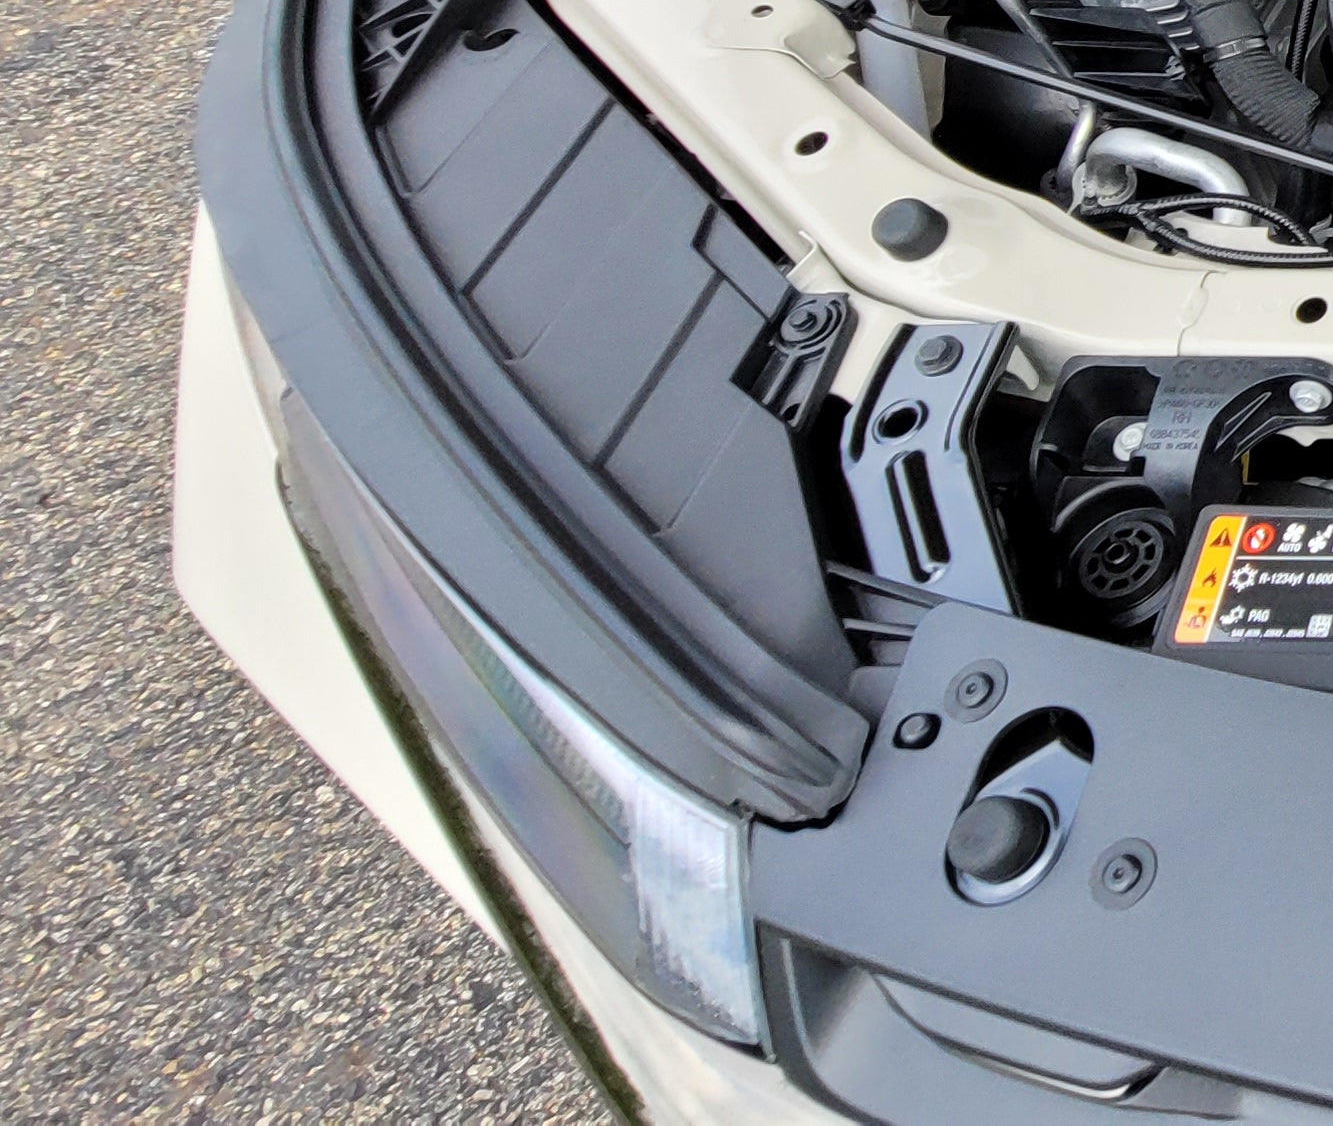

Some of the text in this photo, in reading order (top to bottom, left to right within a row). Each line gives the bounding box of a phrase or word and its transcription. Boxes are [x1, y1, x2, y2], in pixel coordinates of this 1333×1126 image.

[1277, 542, 1302, 552] AUTO
[1259, 572, 1304, 587] R-1234yf
[1247, 608, 1271, 623] PAG
